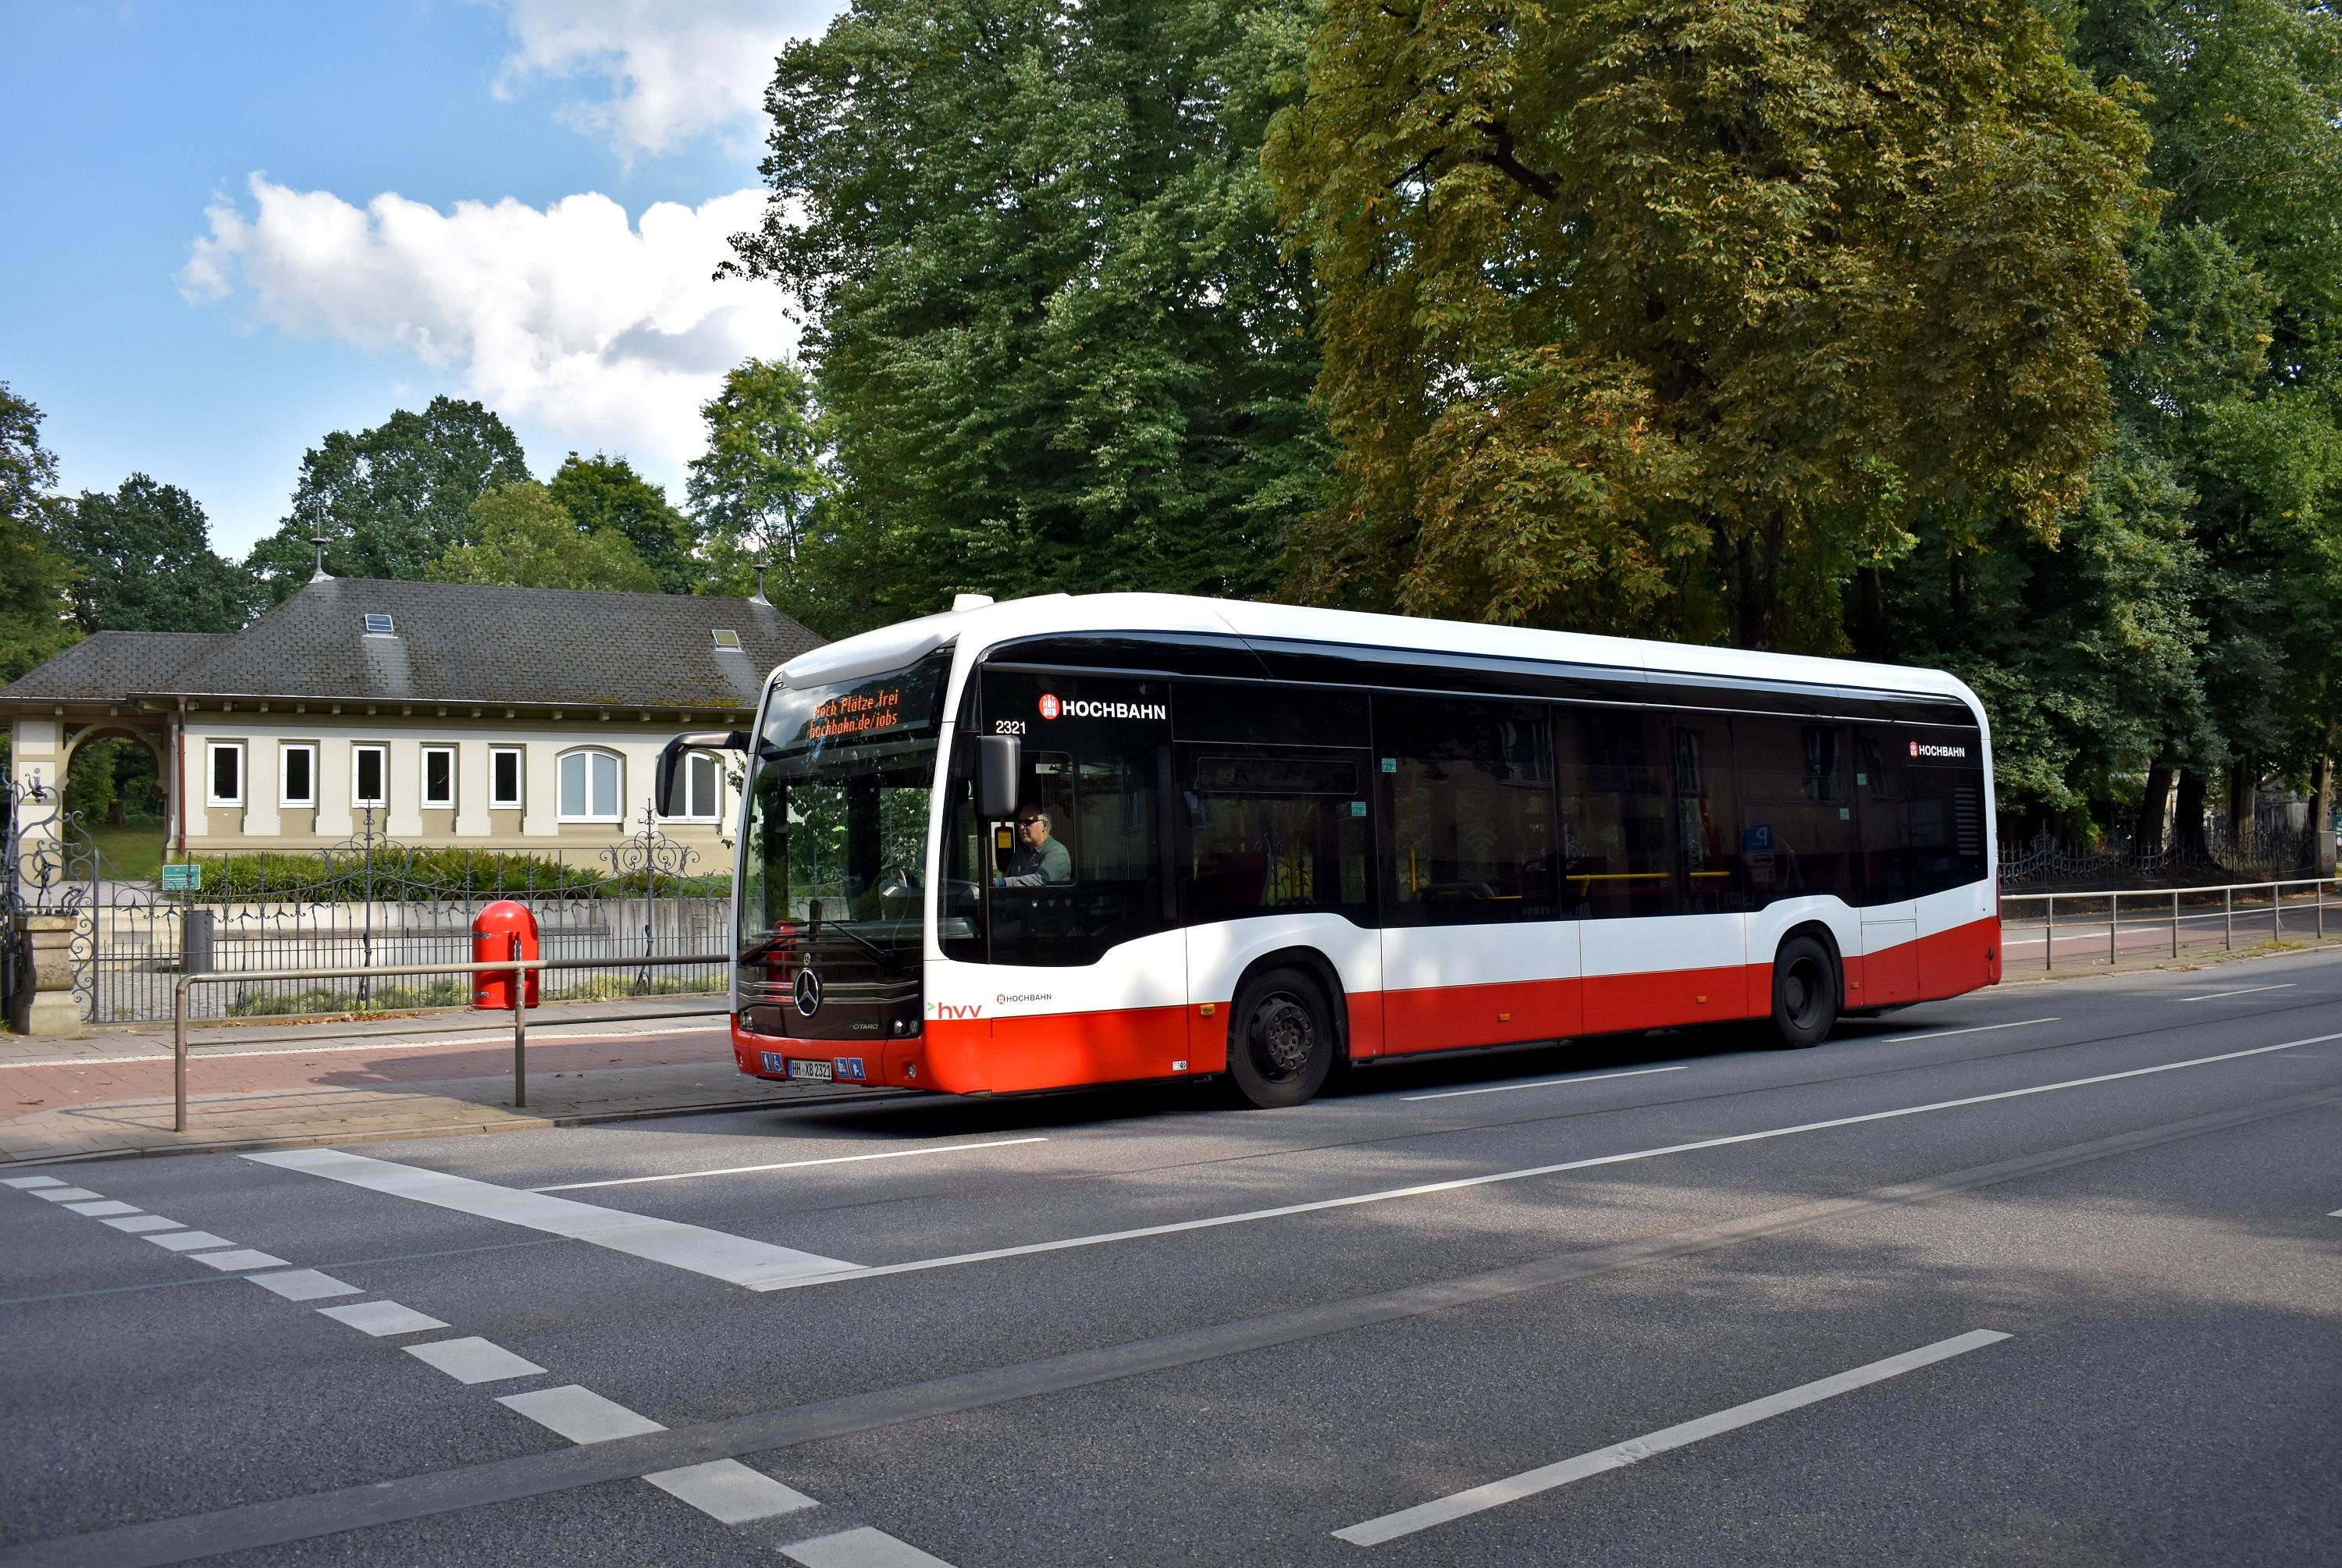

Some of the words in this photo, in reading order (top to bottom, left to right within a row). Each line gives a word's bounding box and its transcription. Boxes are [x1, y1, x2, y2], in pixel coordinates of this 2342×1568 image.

[878, 689, 899, 708] frei
[1062, 700, 1166, 720] HOCHBAHN
[995, 720, 1026, 734] 2321
[1919, 745, 1965, 757] HOCHBAHN
[1006, 994, 1052, 1002] HOCHBAHN
[938, 1002, 982, 1019] hvv
[792, 1061, 801, 1076] HH
[805, 1062, 814, 1076] XB
[814, 1063, 831, 1078] 2321
